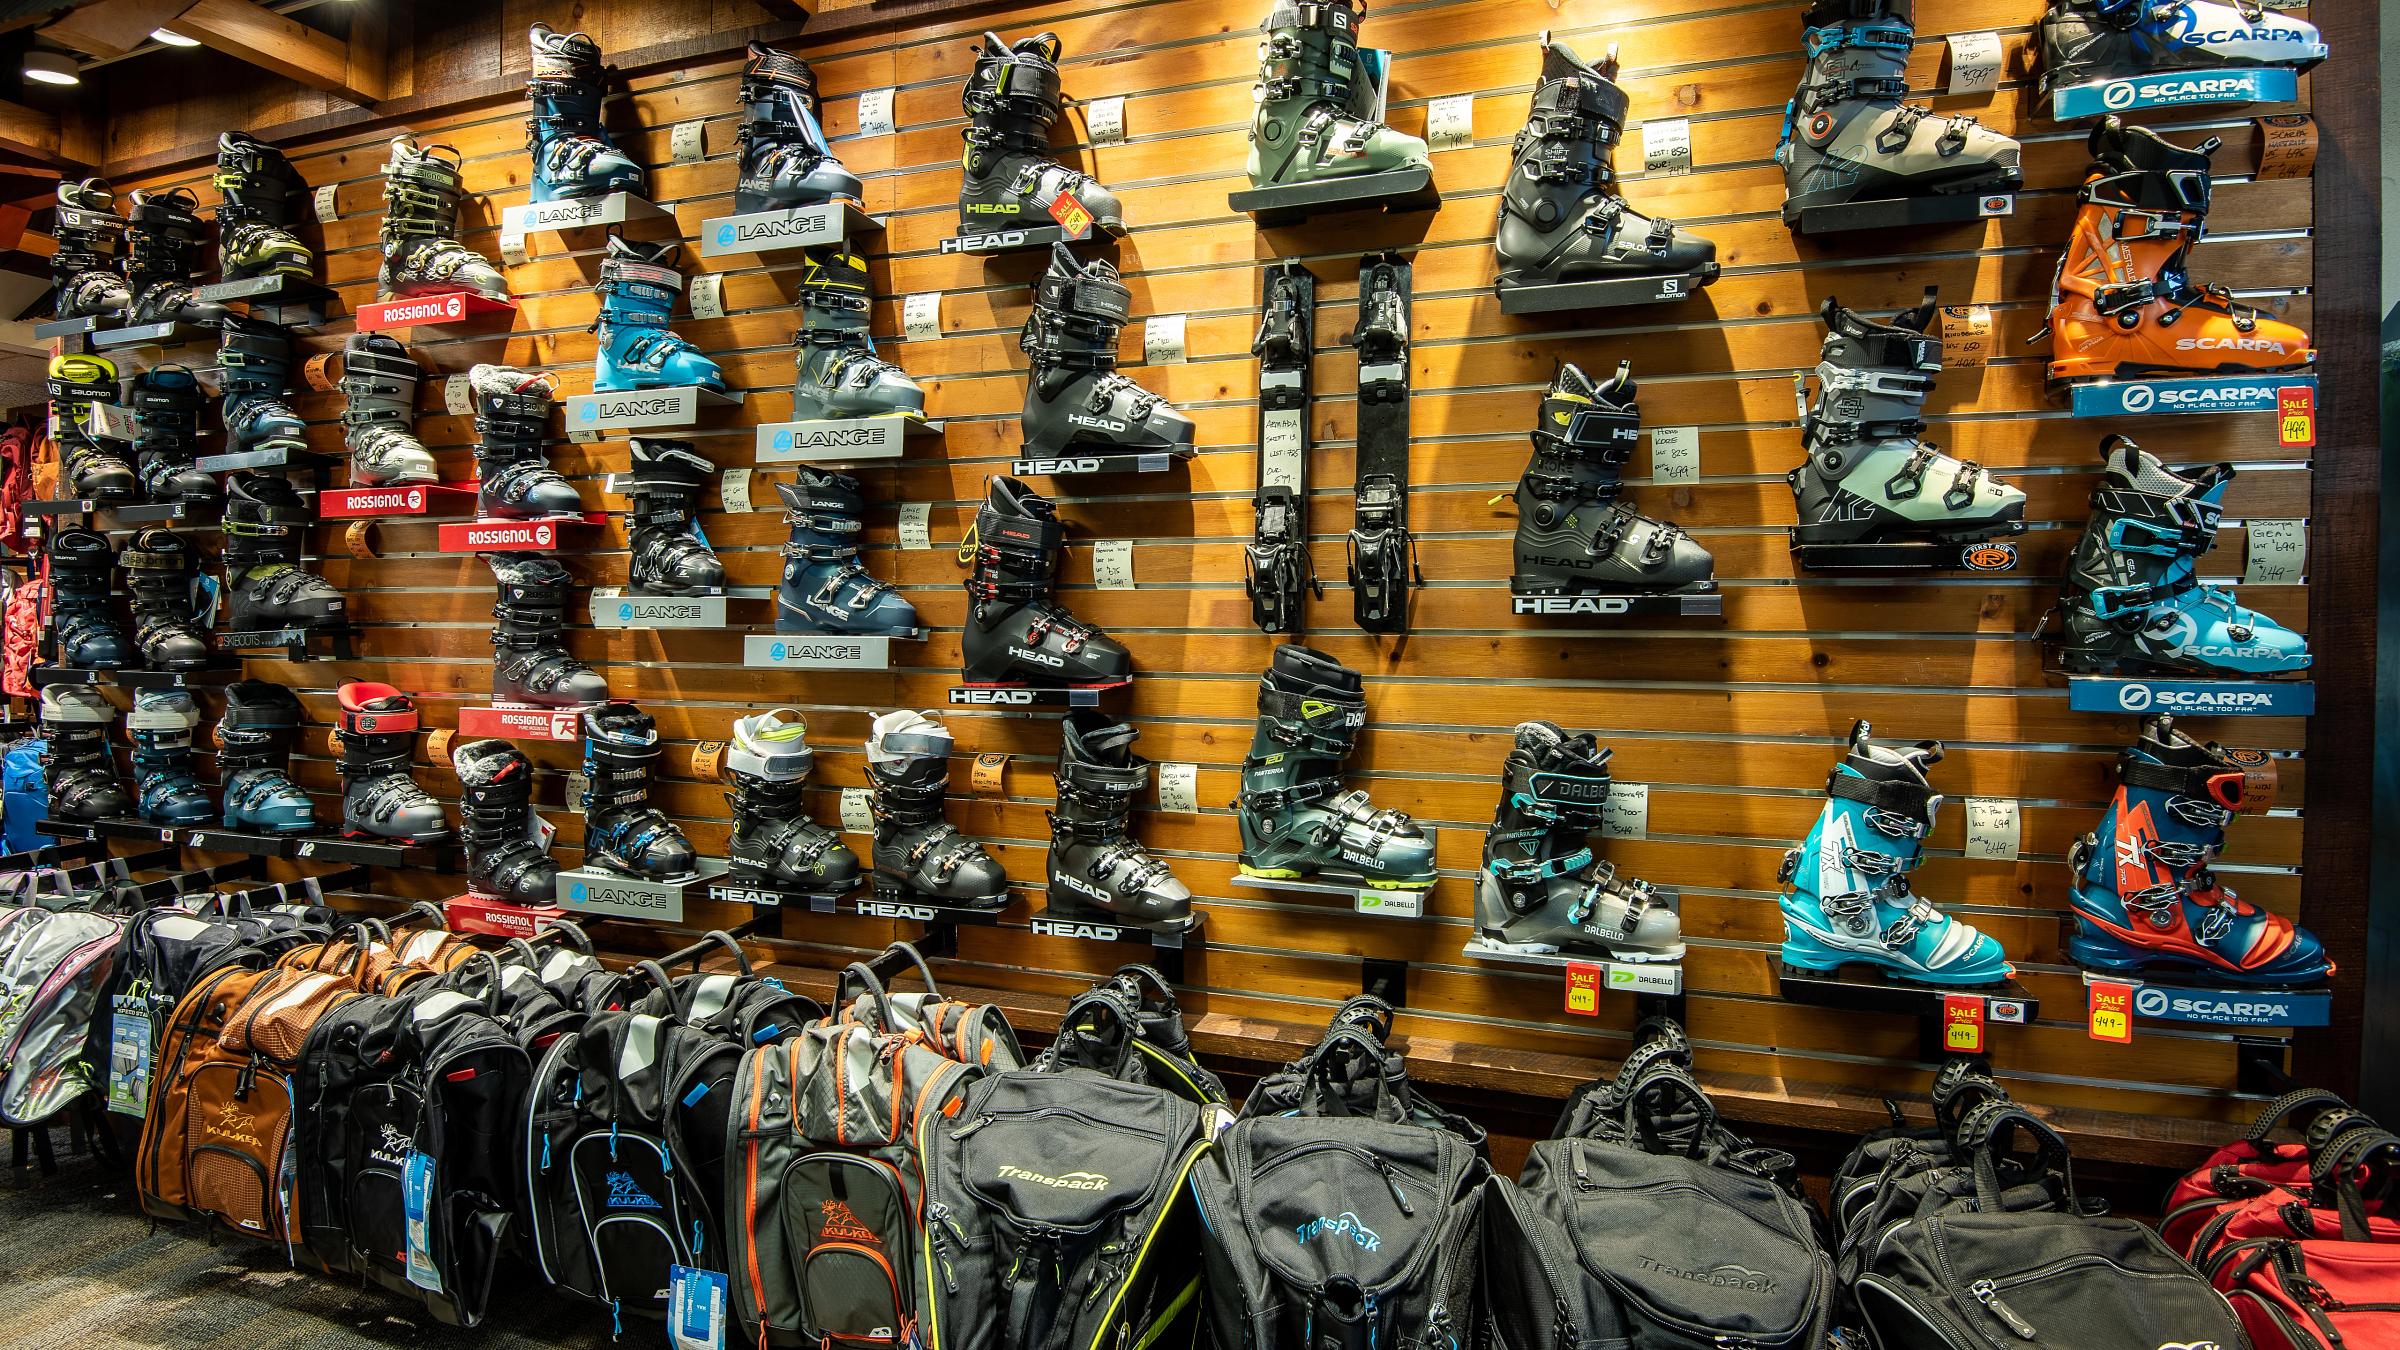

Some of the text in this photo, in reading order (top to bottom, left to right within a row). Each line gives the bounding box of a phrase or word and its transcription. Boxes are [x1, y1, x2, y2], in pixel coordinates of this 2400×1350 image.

[2182, 28, 2304, 46] SCARPA
[2139, 79, 2254, 97] SCARPA
[1545, 149, 1570, 157] SHIFT
[1649, 147, 1689, 157] LIST: 850
[1647, 161, 1671, 171] OUR:
[739, 178, 770, 192] LANGE
[539, 204, 602, 224] LANGE
[966, 203, 1021, 215] HEAD
[1056, 197, 1073, 219] SALE
[738, 215, 826, 241] LANGE
[942, 233, 1024, 253] HEAD
[383, 303, 444, 322] ROSSIGNOL
[1101, 302, 1123, 311] HEAD
[1963, 342, 1980, 351] 650
[2176, 338, 2285, 356] SCARPA
[2158, 387, 2272, 402] SCARPA
[600, 398, 680, 419] LANGE
[2282, 399, 2308, 410] SALE
[2288, 409, 2304, 417] Price
[1068, 413, 1126, 433] HEAD
[1266, 420, 1297, 428] ARMADA
[795, 428, 886, 449] LANGE
[1014, 459, 1099, 475] HEAD
[347, 493, 406, 509] ROSSIGNOL
[812, 500, 845, 509] LANGE
[468, 528, 533, 545] ROSSIGNOL
[1002, 529, 1030, 539] HEAD
[1969, 543, 2010, 554] FIRST RUN
[1523, 555, 1594, 570] HEAD
[2126, 558, 2136, 577] GEA
[634, 605, 701, 619] LANGE
[806, 595, 849, 622] LANGE
[1515, 598, 1629, 614] HEAD
[788, 645, 861, 660] LANGE
[1008, 646, 1065, 668] HEAD
[2184, 644, 2284, 659] SCARPA
[950, 690, 1033, 704] HEAD
[2155, 691, 2272, 706] SCARPA
[502, 713, 549, 727] ROSSIGNOL
[1264, 753, 1284, 765] 120
[1254, 766, 1285, 778] PANTERRA
[1105, 782, 1143, 792] HEAD
[1993, 819, 2010, 829] 699
[190, 833, 204, 847] K2
[298, 843, 315, 856] K2
[2116, 837, 2145, 870] TX
[733, 855, 768, 869] HEAD
[1343, 850, 1385, 871] DALBELLO
[1054, 870, 1112, 904] HEAD
[589, 889, 667, 909] LANGE
[709, 888, 780, 905] HEAD
[857, 902, 935, 921] HEAD
[1384, 899, 1416, 910] DALBELLO
[485, 912, 531, 927] ROSSIGNOL
[1032, 921, 1118, 942] HEAD
[1584, 924, 1625, 942] DALBELLO
[1570, 971, 1595, 984] SALE
[1638, 975, 1673, 986] DALBELLO
[2095, 993, 2125, 1006] SALE
[1950, 1006, 1977, 1018] SALE
[2100, 1003, 2120, 1012] Price
[2172, 1000, 2287, 1016] SCARPA
[1954, 1016, 1974, 1024] Price
[2201, 1014, 2230, 1022] PLACE
[207, 1126, 262, 1147] KULKEA
[999, 1165, 1110, 1192] Transpack
[1296, 1216, 1382, 1252] Transpack
[1637, 1254, 1778, 1296] Transpack
